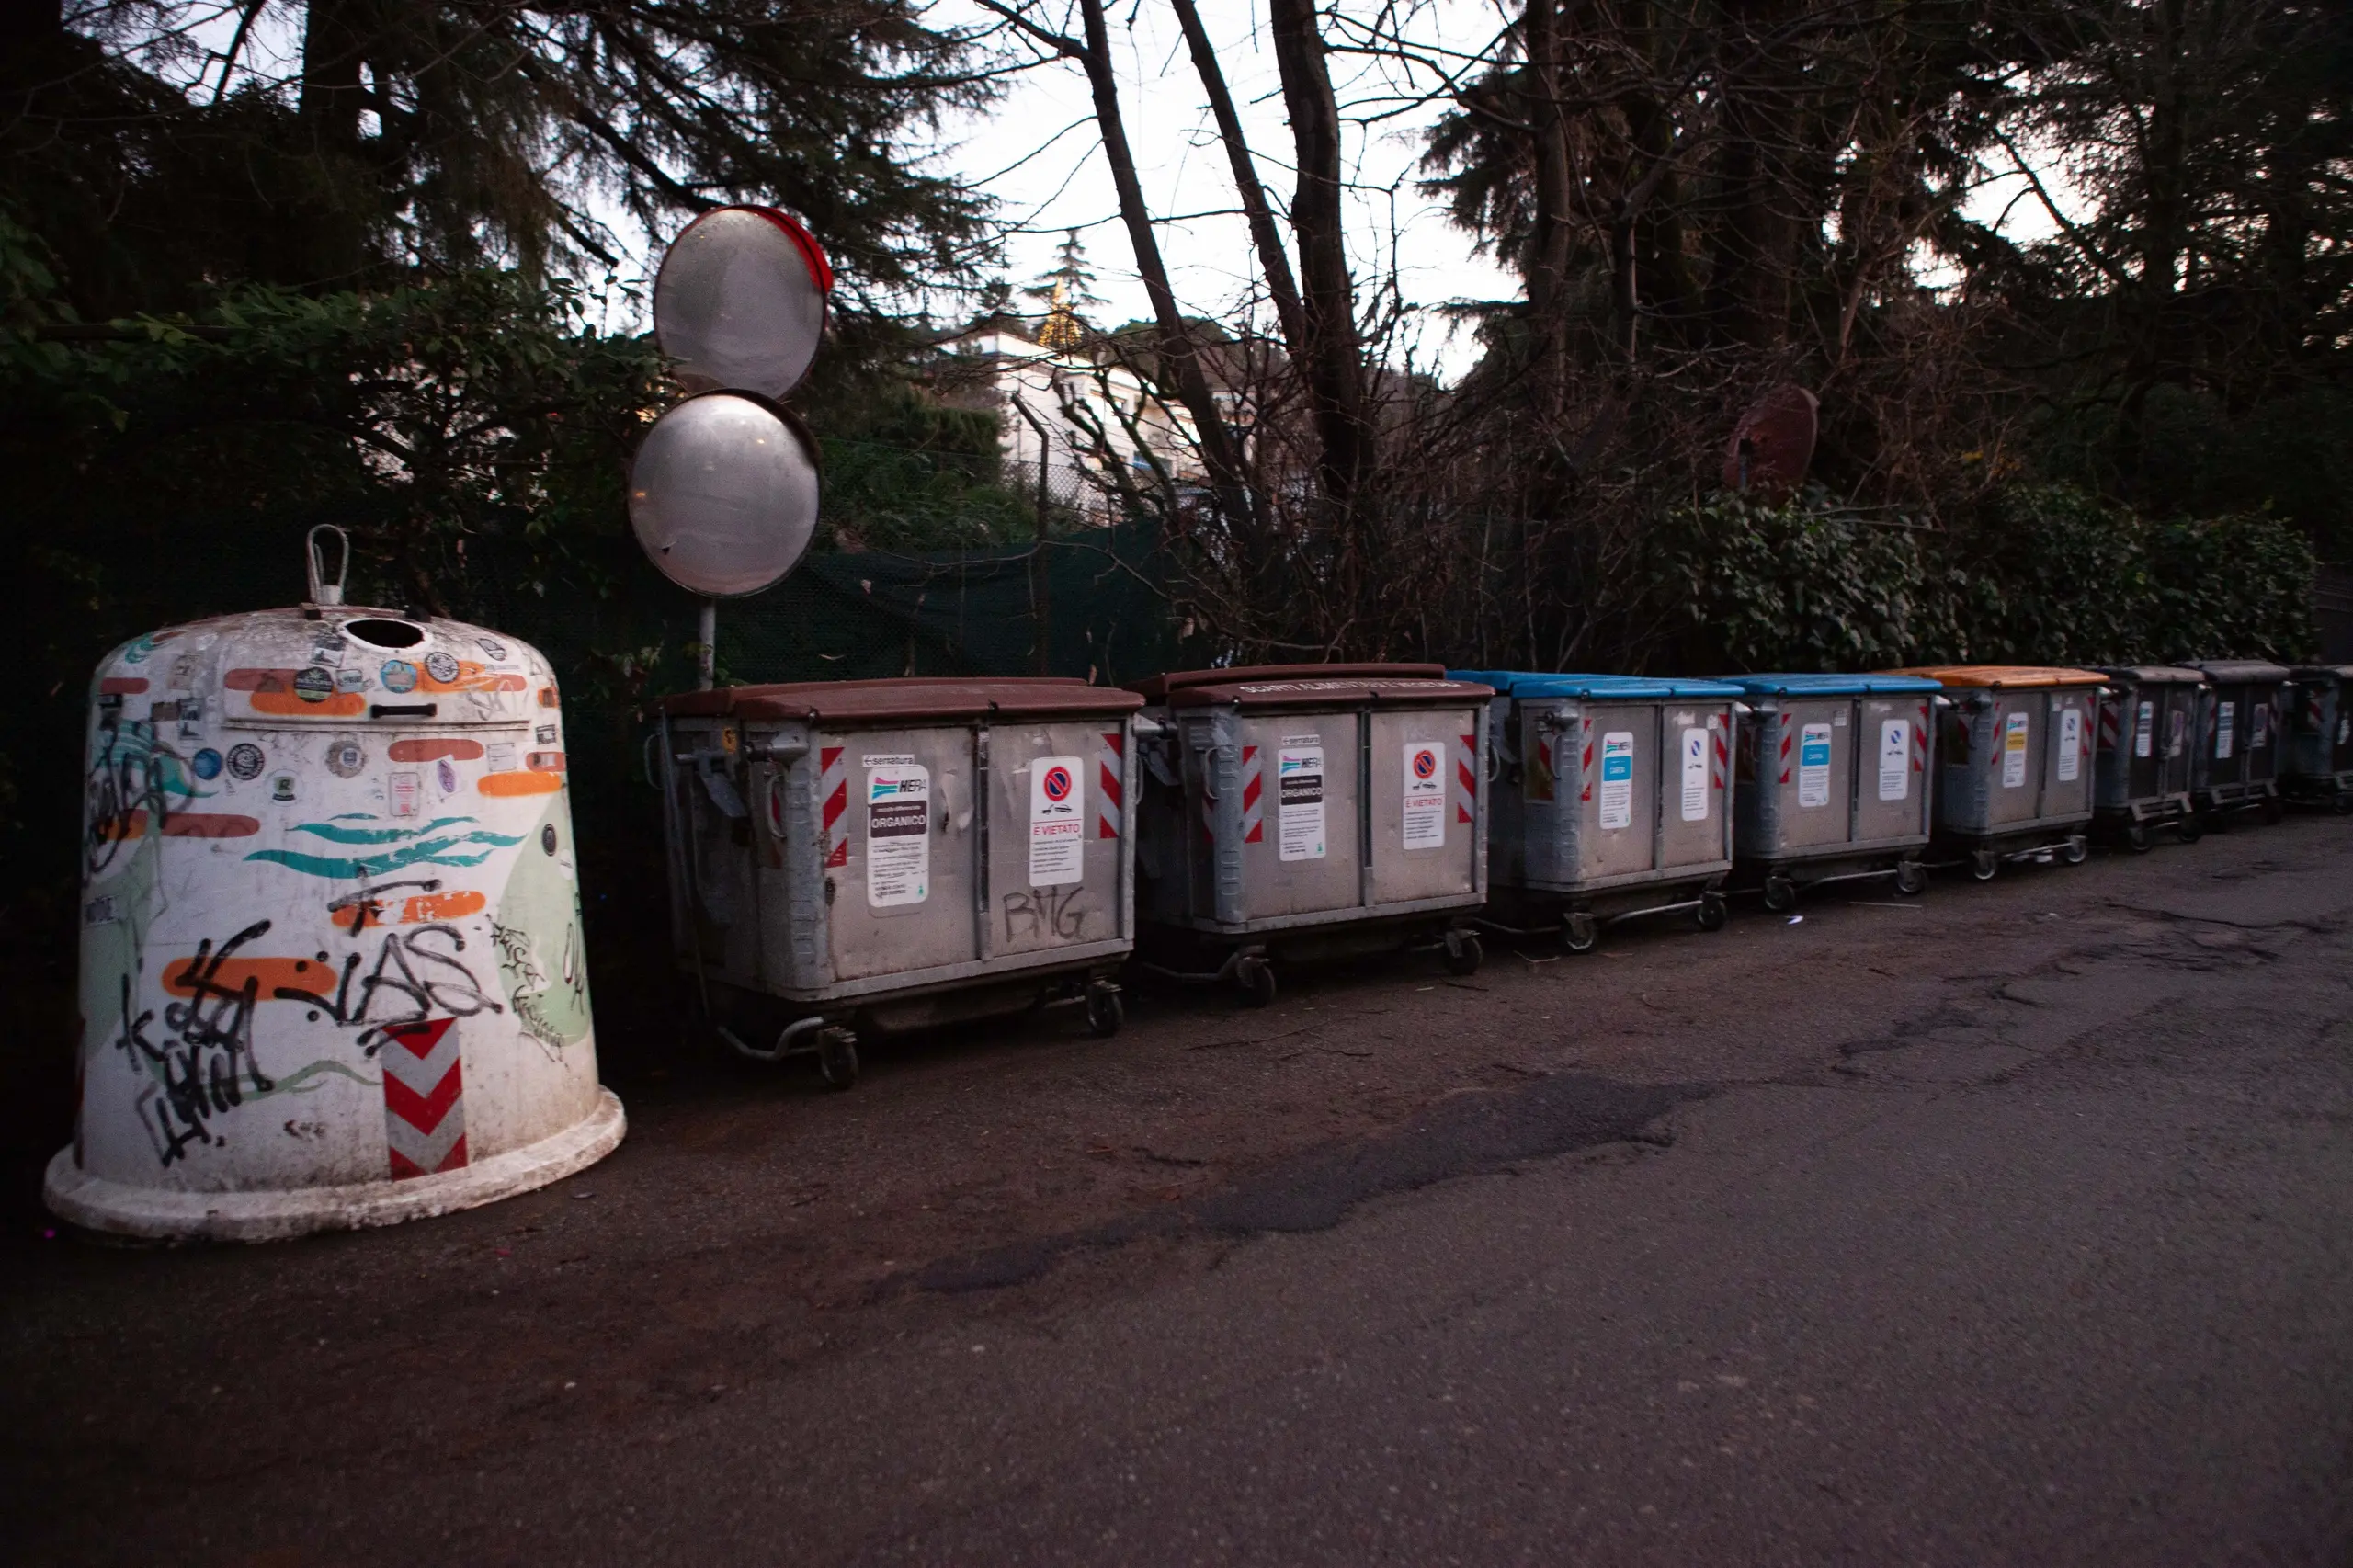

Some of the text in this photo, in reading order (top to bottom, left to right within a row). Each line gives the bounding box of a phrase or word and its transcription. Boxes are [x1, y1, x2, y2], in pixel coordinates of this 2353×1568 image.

[872, 756, 914, 766] serratura
[899, 778, 926, 793] HERA
[1281, 786, 1323, 799] ORGANICO
[1413, 797, 1442, 807] VIETATO
[871, 814, 926, 829] ORGANICO
[1042, 823, 1081, 835] VIETATO
